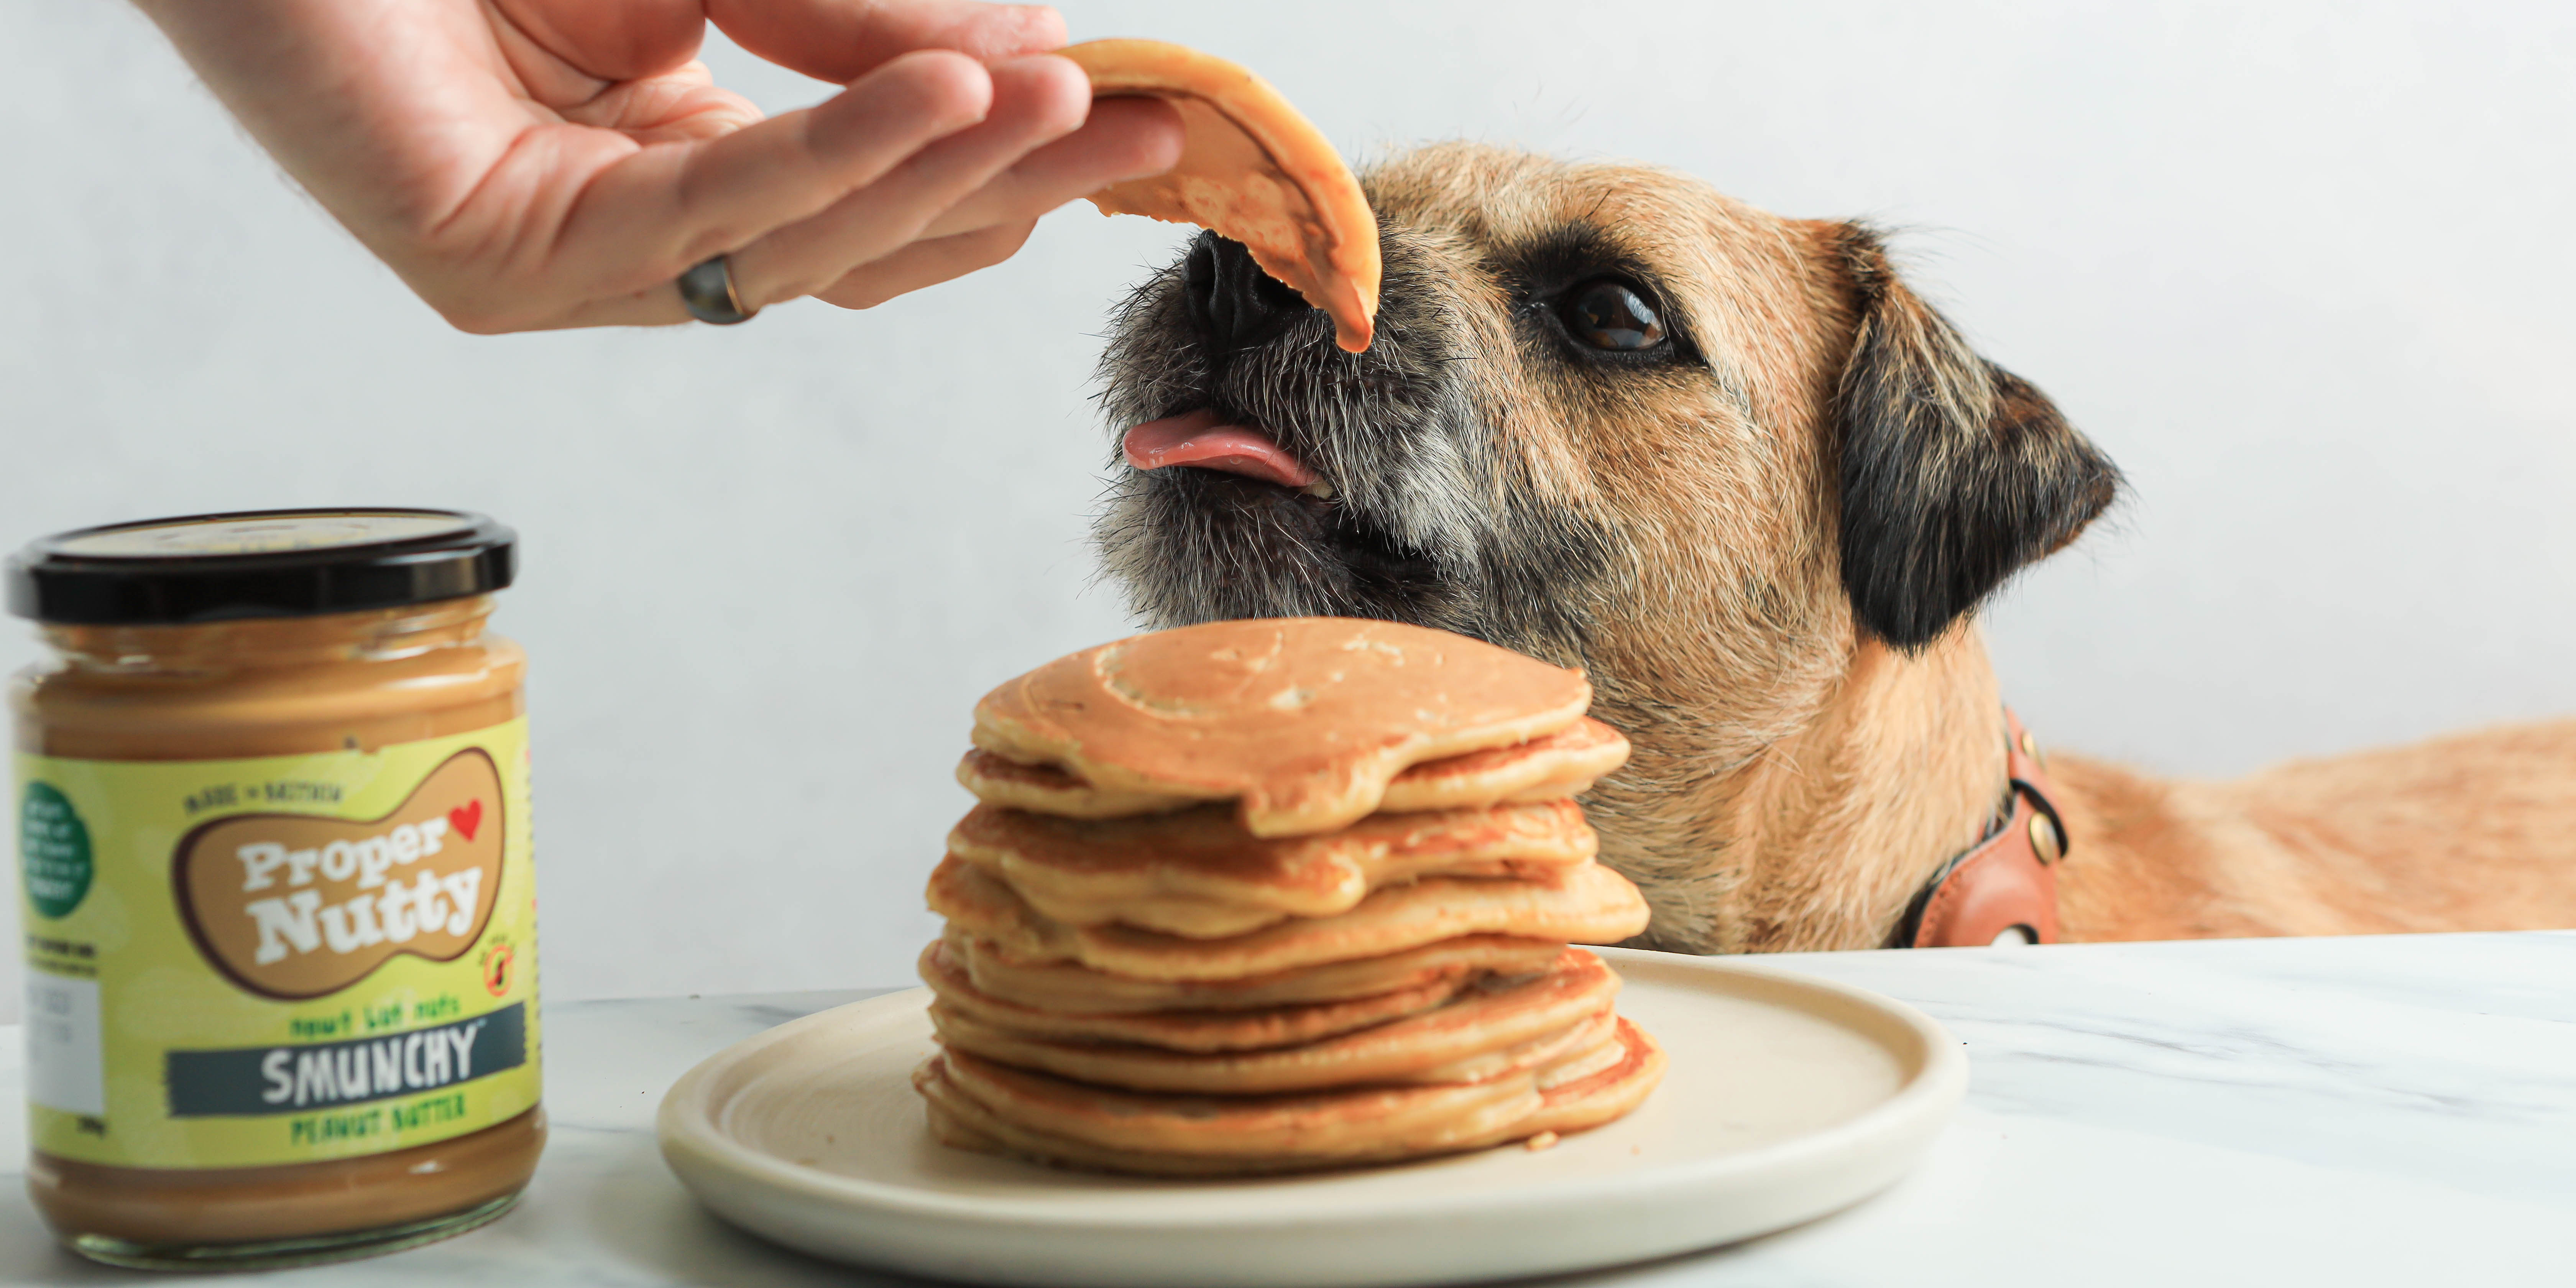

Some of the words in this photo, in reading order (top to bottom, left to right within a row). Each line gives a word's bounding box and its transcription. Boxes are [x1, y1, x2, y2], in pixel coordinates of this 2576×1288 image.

[237, 816, 448, 892] Proper
[245, 866, 482, 965] Nutty
[261, 1022, 478, 1106] SMUNCHY
[291, 1111, 381, 1145] PEANUT
[391, 1092, 465, 1132] BUTTER
